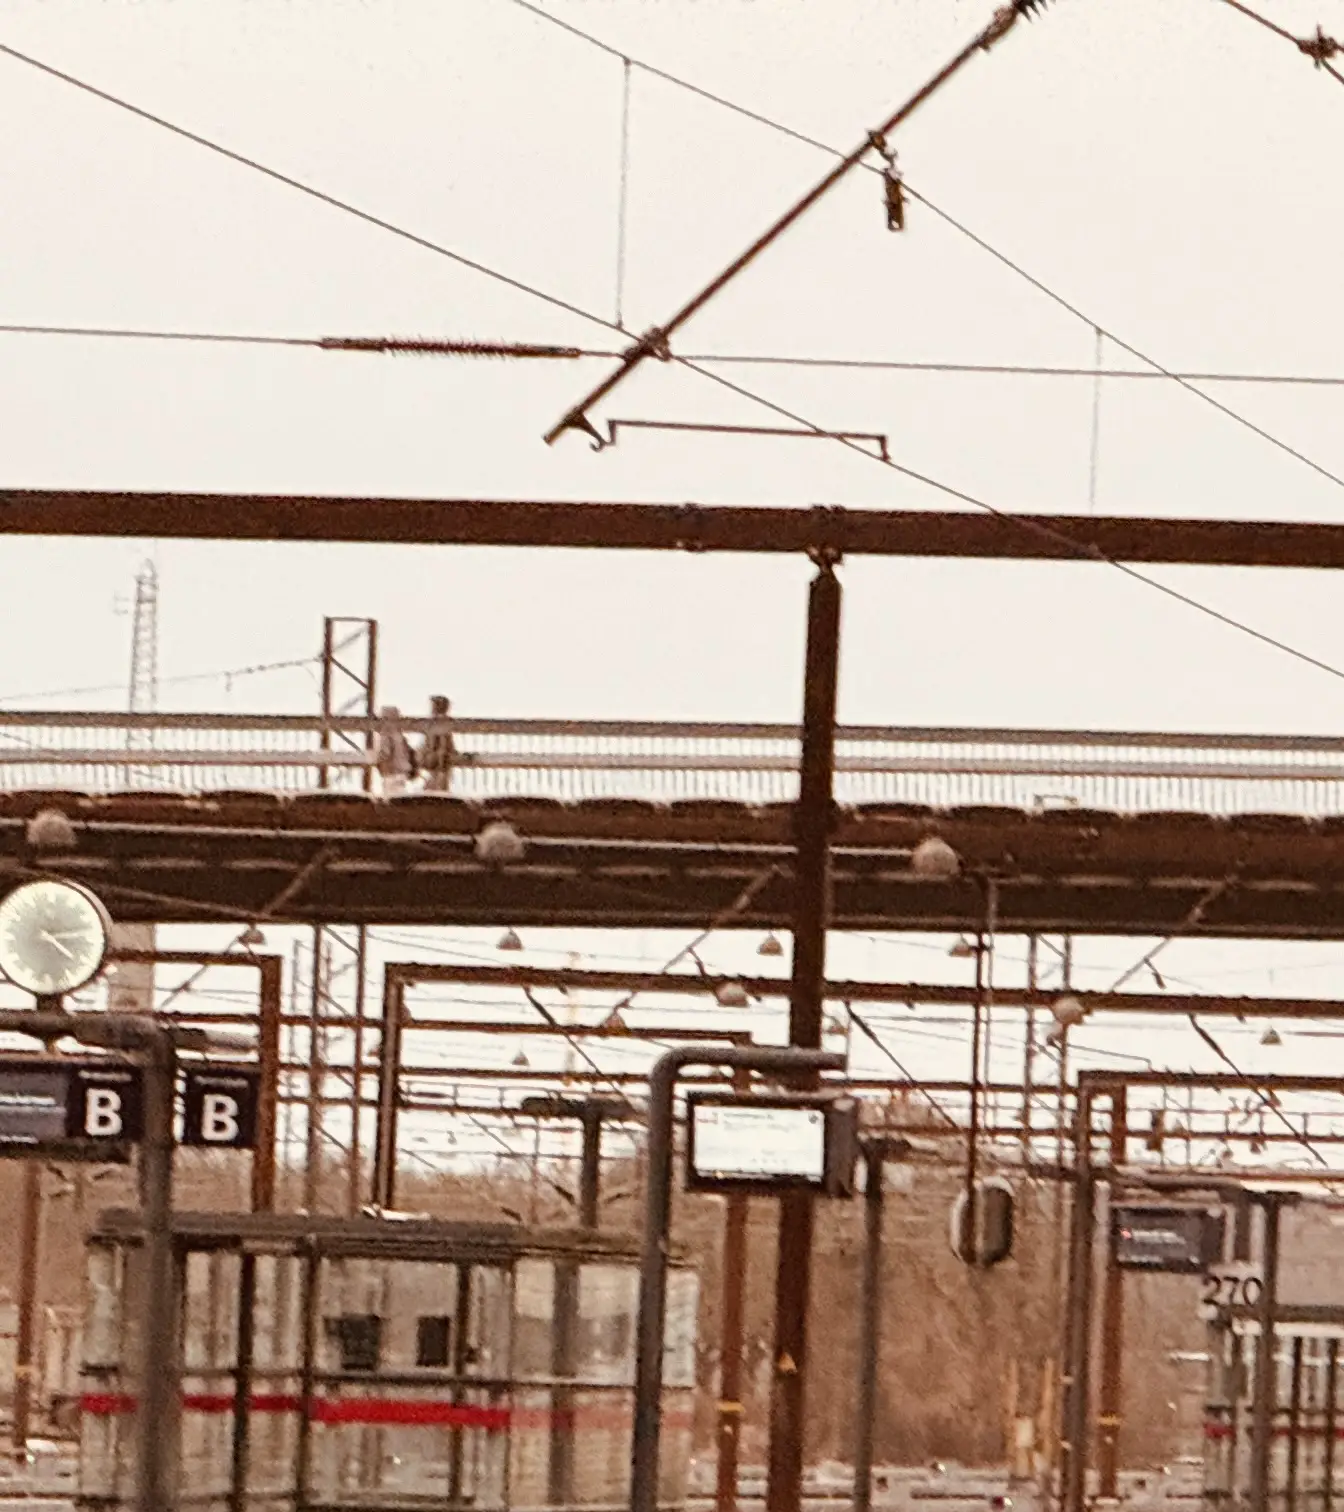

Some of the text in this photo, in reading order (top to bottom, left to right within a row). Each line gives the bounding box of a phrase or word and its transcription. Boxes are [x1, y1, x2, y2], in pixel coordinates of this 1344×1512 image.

[85, 1088, 122, 1136] B
[201, 1094, 239, 1141] B
[1202, 1275, 1264, 1308] 270
